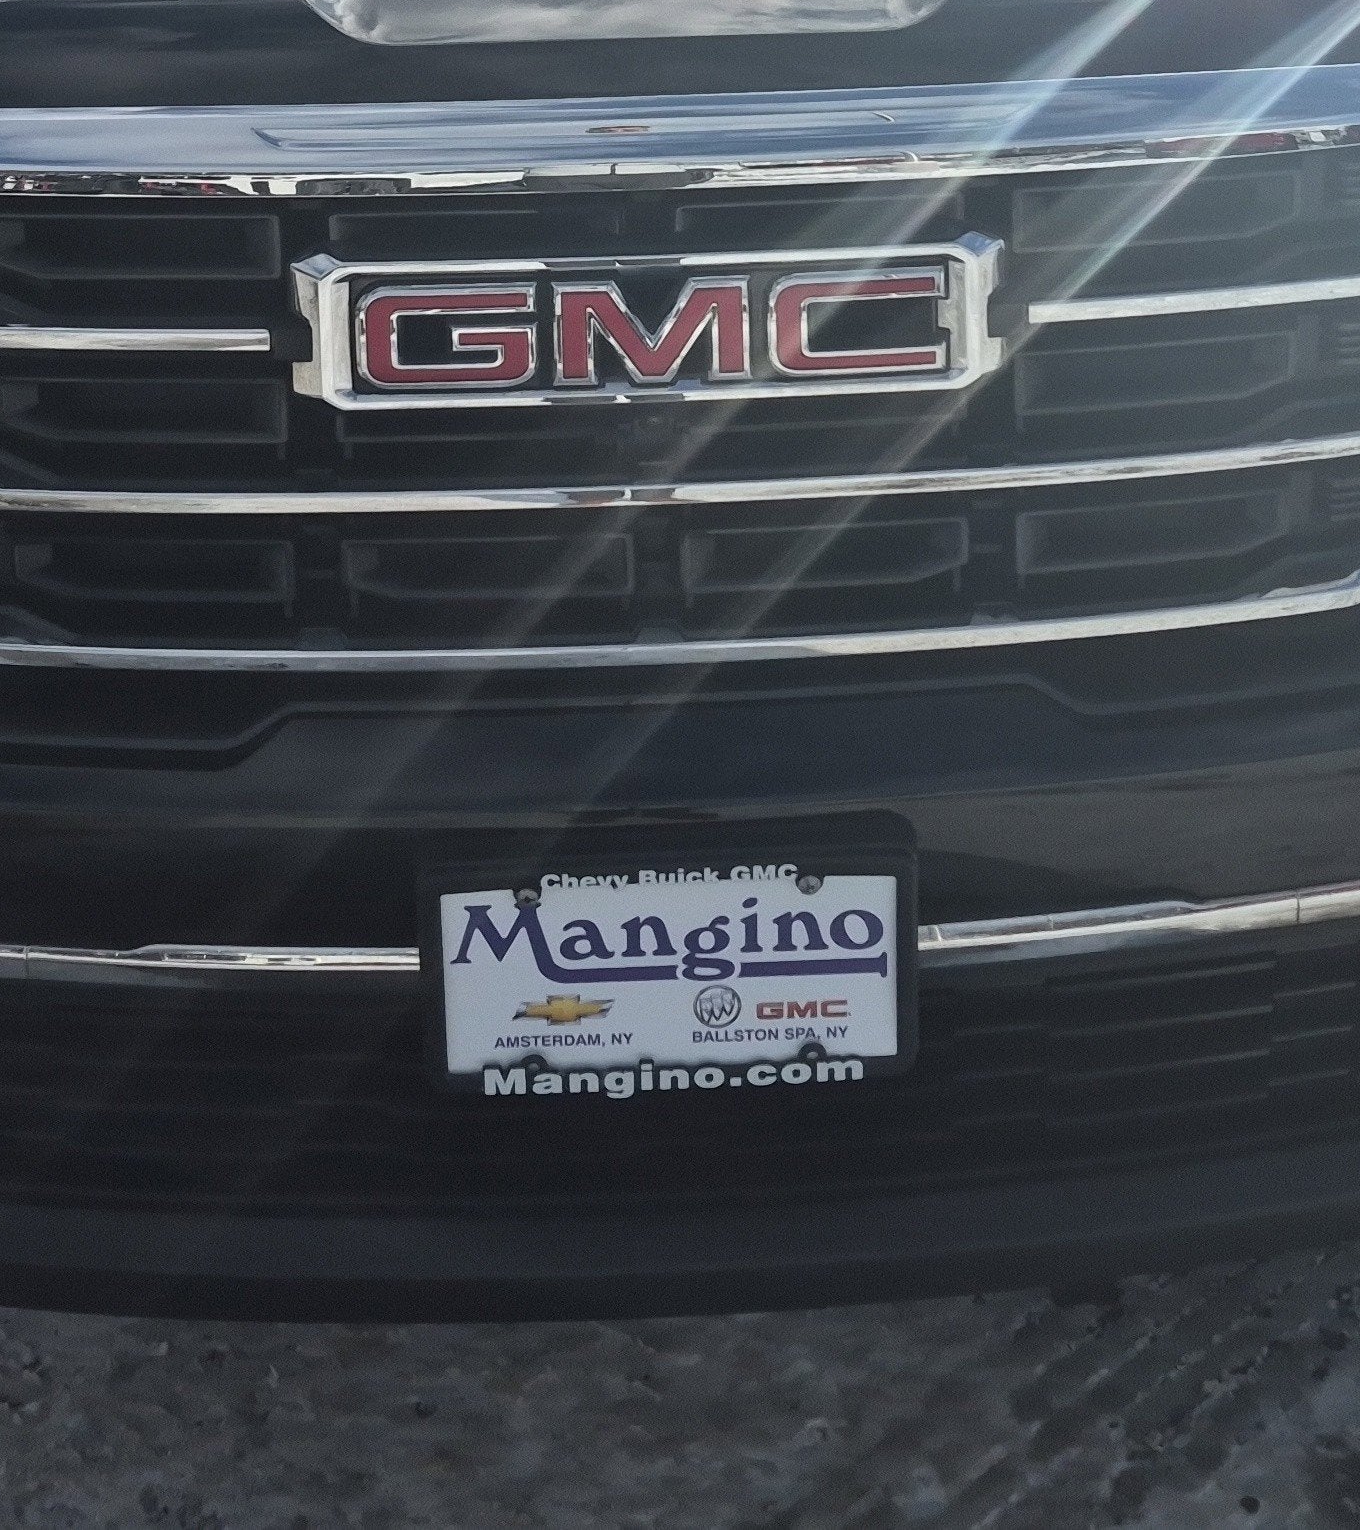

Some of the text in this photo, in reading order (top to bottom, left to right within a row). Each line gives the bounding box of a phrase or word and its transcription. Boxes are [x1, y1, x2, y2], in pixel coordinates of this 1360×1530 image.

[356, 266, 949, 388] GMC
[540, 863, 799, 891] Chevy Buick GMC
[449, 896, 888, 983] Mangino
[755, 1000, 849, 1021] GMC
[494, 1032, 634, 1049] AMSTERDAM, NY
[691, 1025, 849, 1044] BALLSTON SPA, NY
[483, 1059, 865, 1100] Mangino.com
